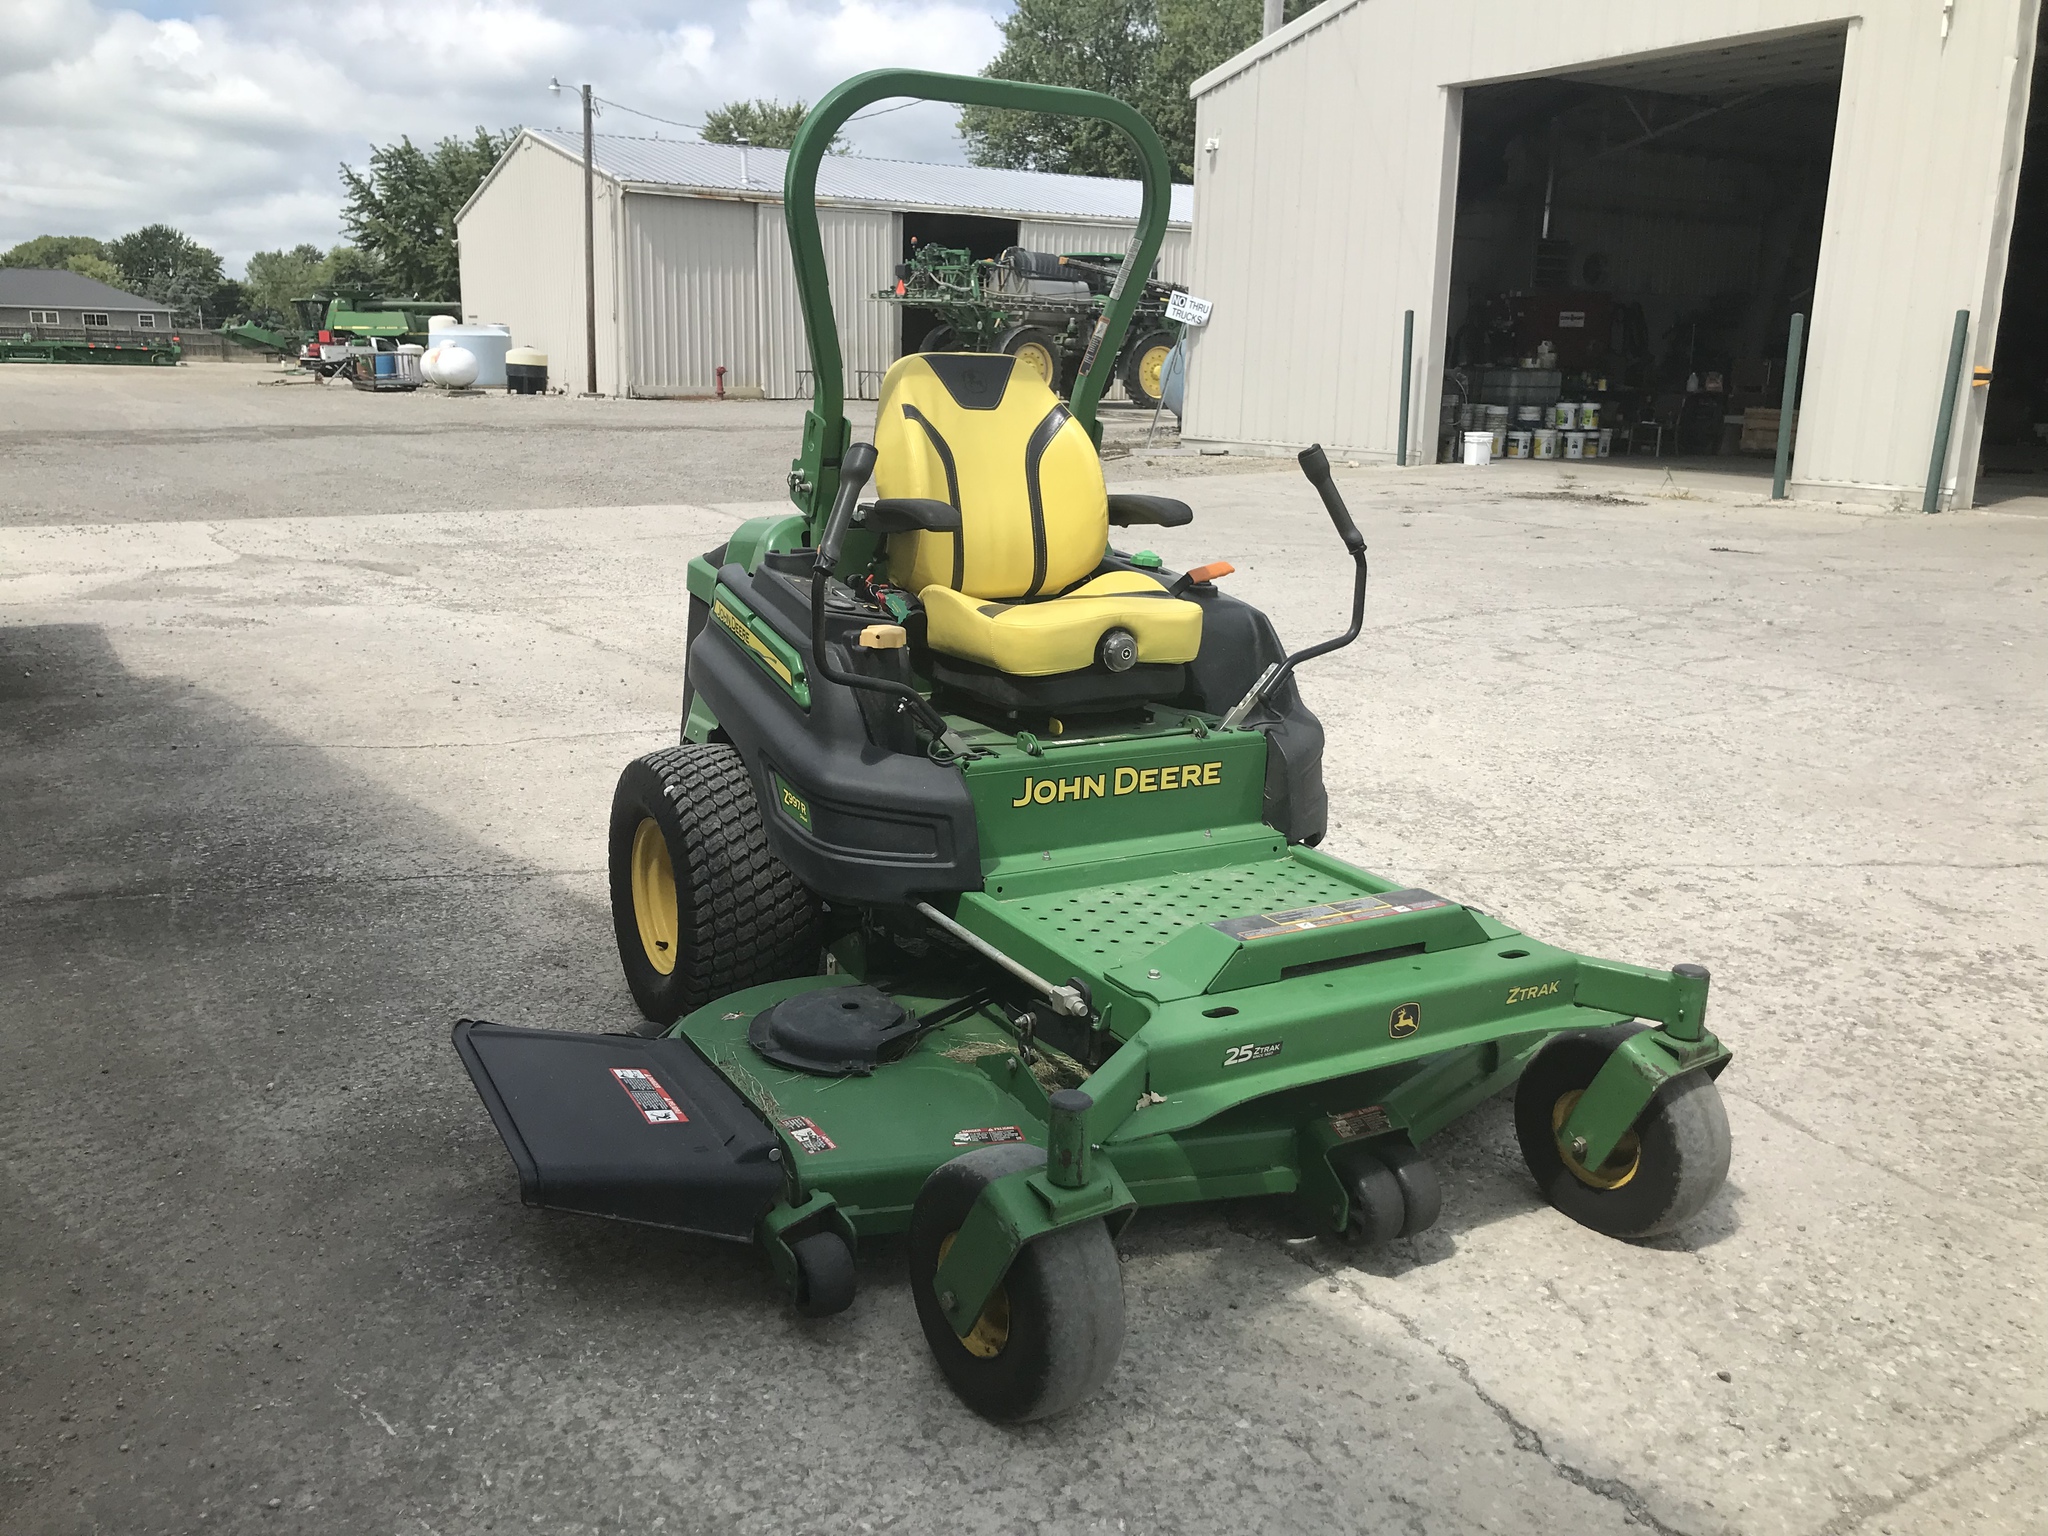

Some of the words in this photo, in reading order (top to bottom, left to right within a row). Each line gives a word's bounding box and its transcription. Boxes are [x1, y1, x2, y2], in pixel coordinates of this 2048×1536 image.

[1172, 294, 1187, 308] NO
[1189, 300, 1209, 314] THRU
[1172, 307, 1203, 325] TRUCKS
[1012, 776, 1106, 808] JOHN
[1113, 761, 1222, 796] DEERE
[1505, 979, 1560, 1005] ZTRAK
[1223, 1043, 1255, 1066] 25
[1253, 1043, 1281, 1055] ZTRAK
